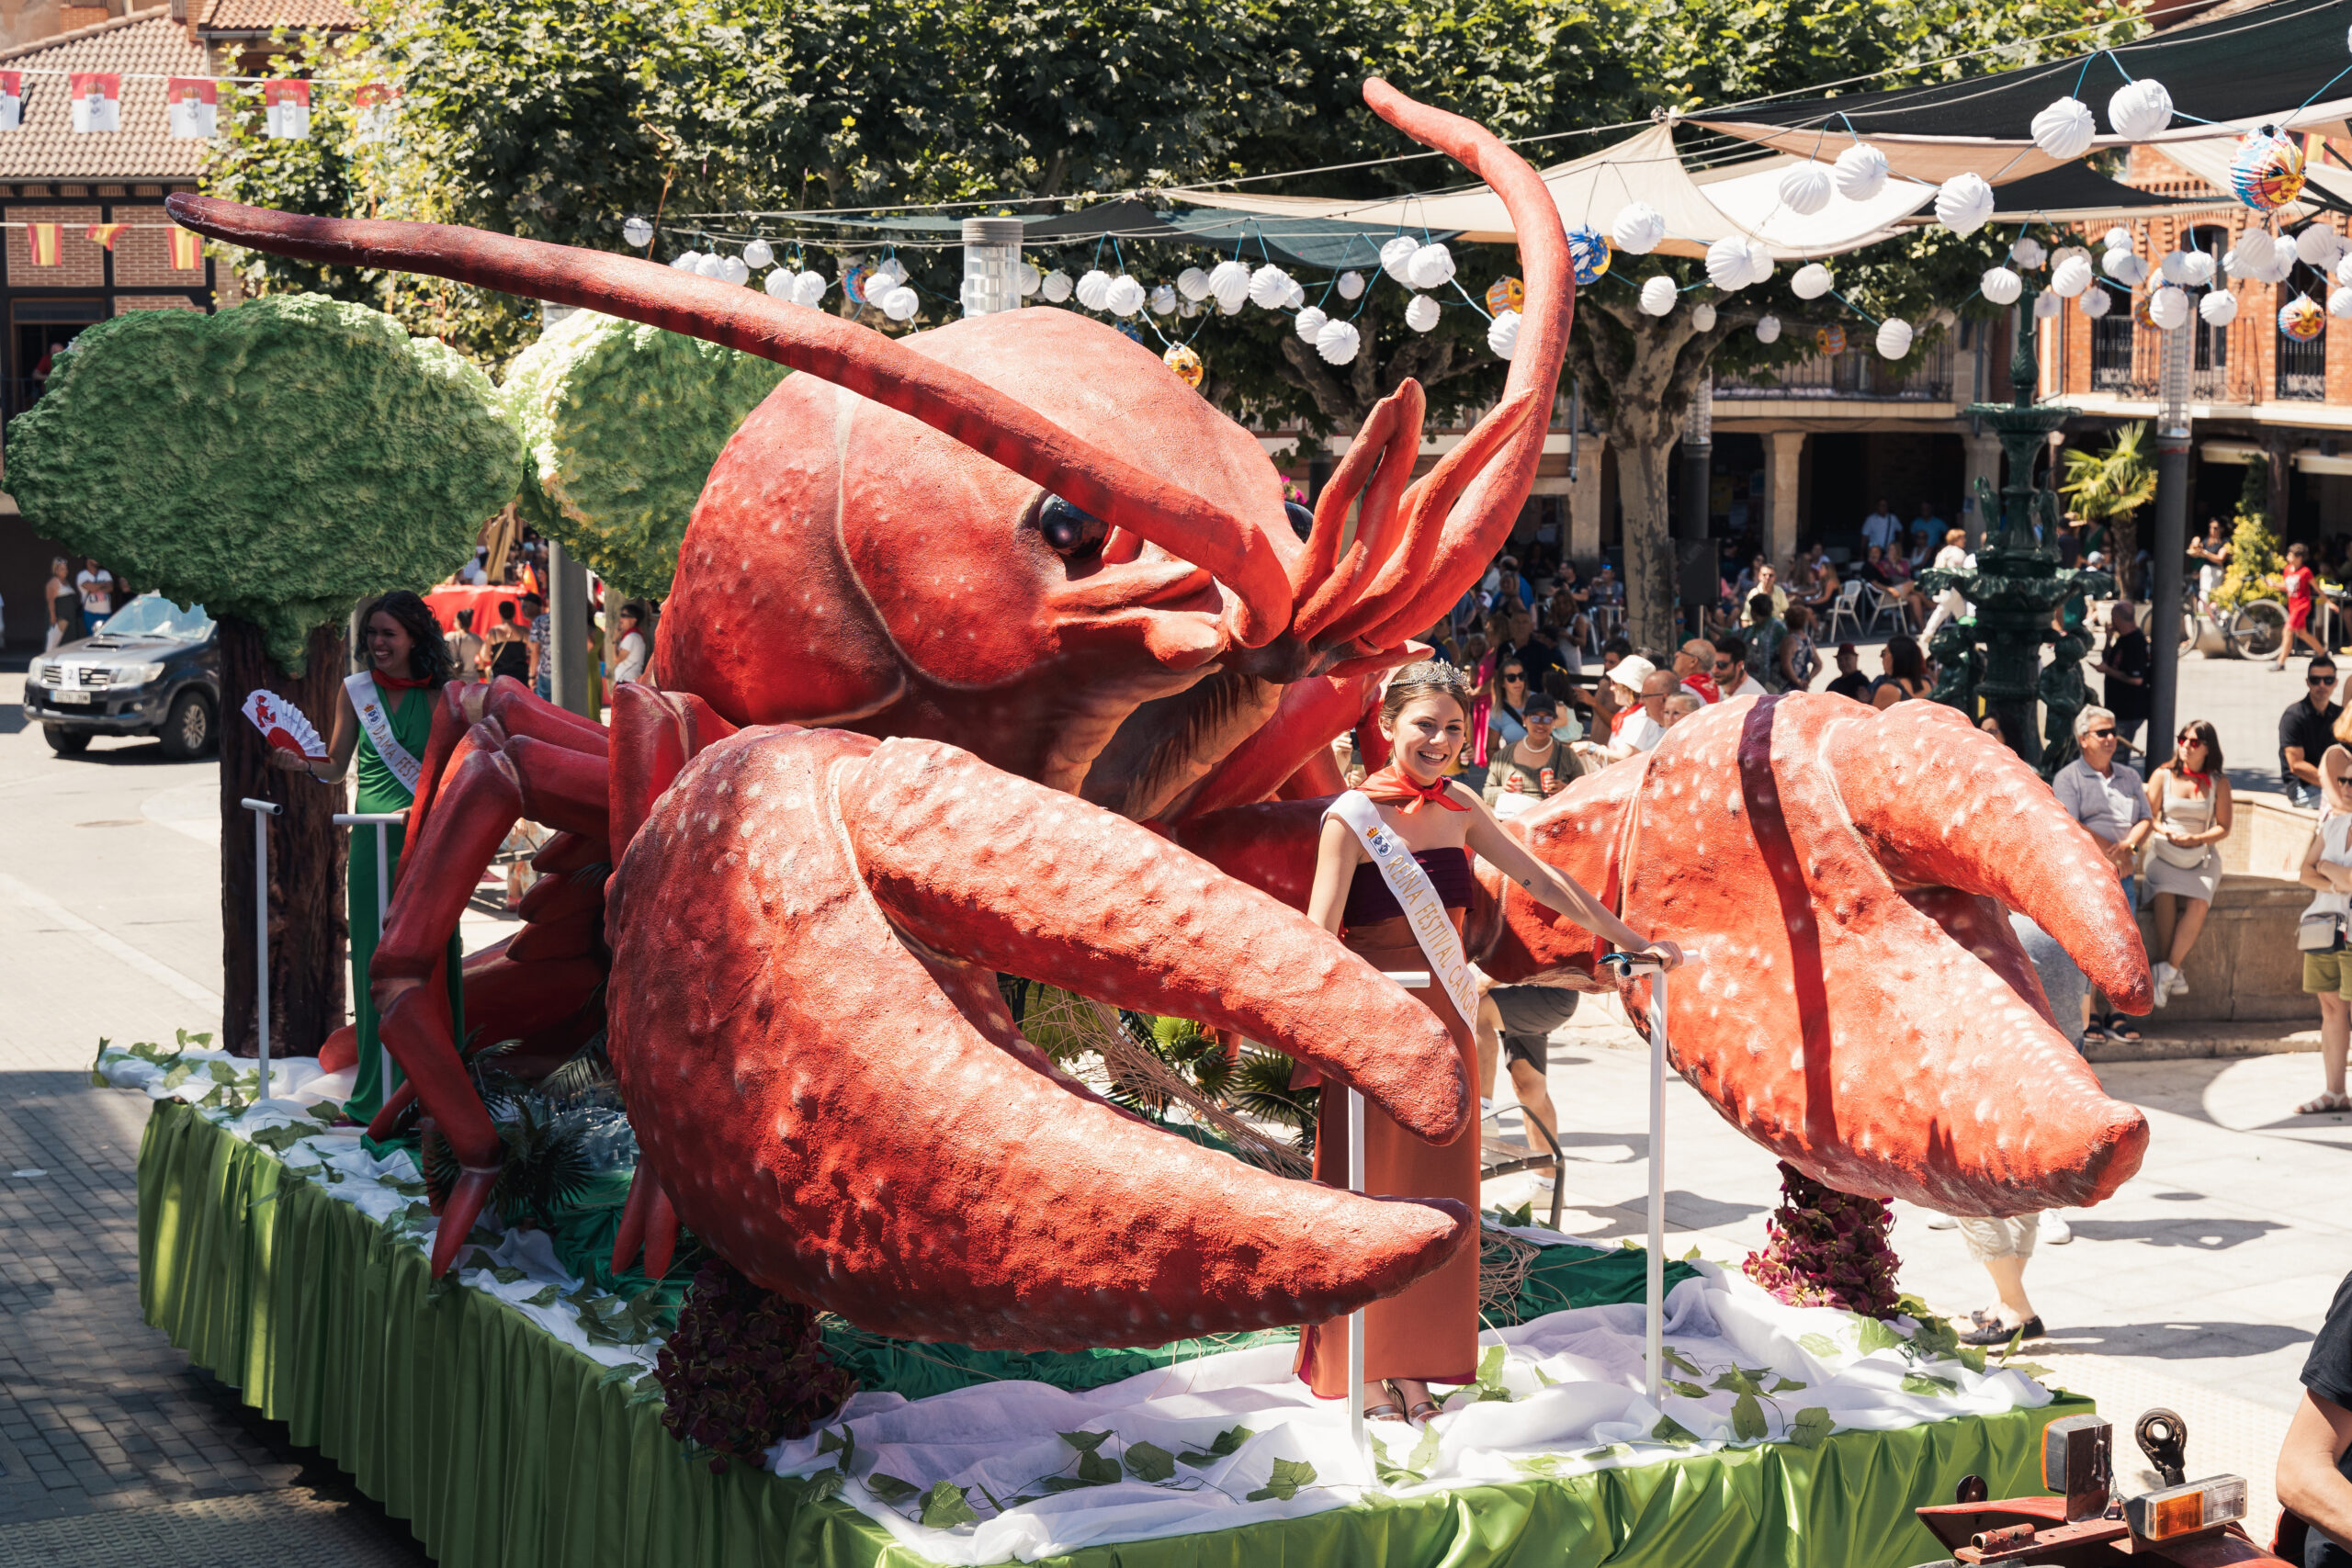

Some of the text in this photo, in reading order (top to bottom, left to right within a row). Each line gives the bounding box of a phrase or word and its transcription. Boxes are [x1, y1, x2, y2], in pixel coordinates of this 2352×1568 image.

[373, 724, 397, 761] DAMA
[1385, 854, 1424, 906] REINA
[1414, 900, 1456, 969] FESTIVAL
